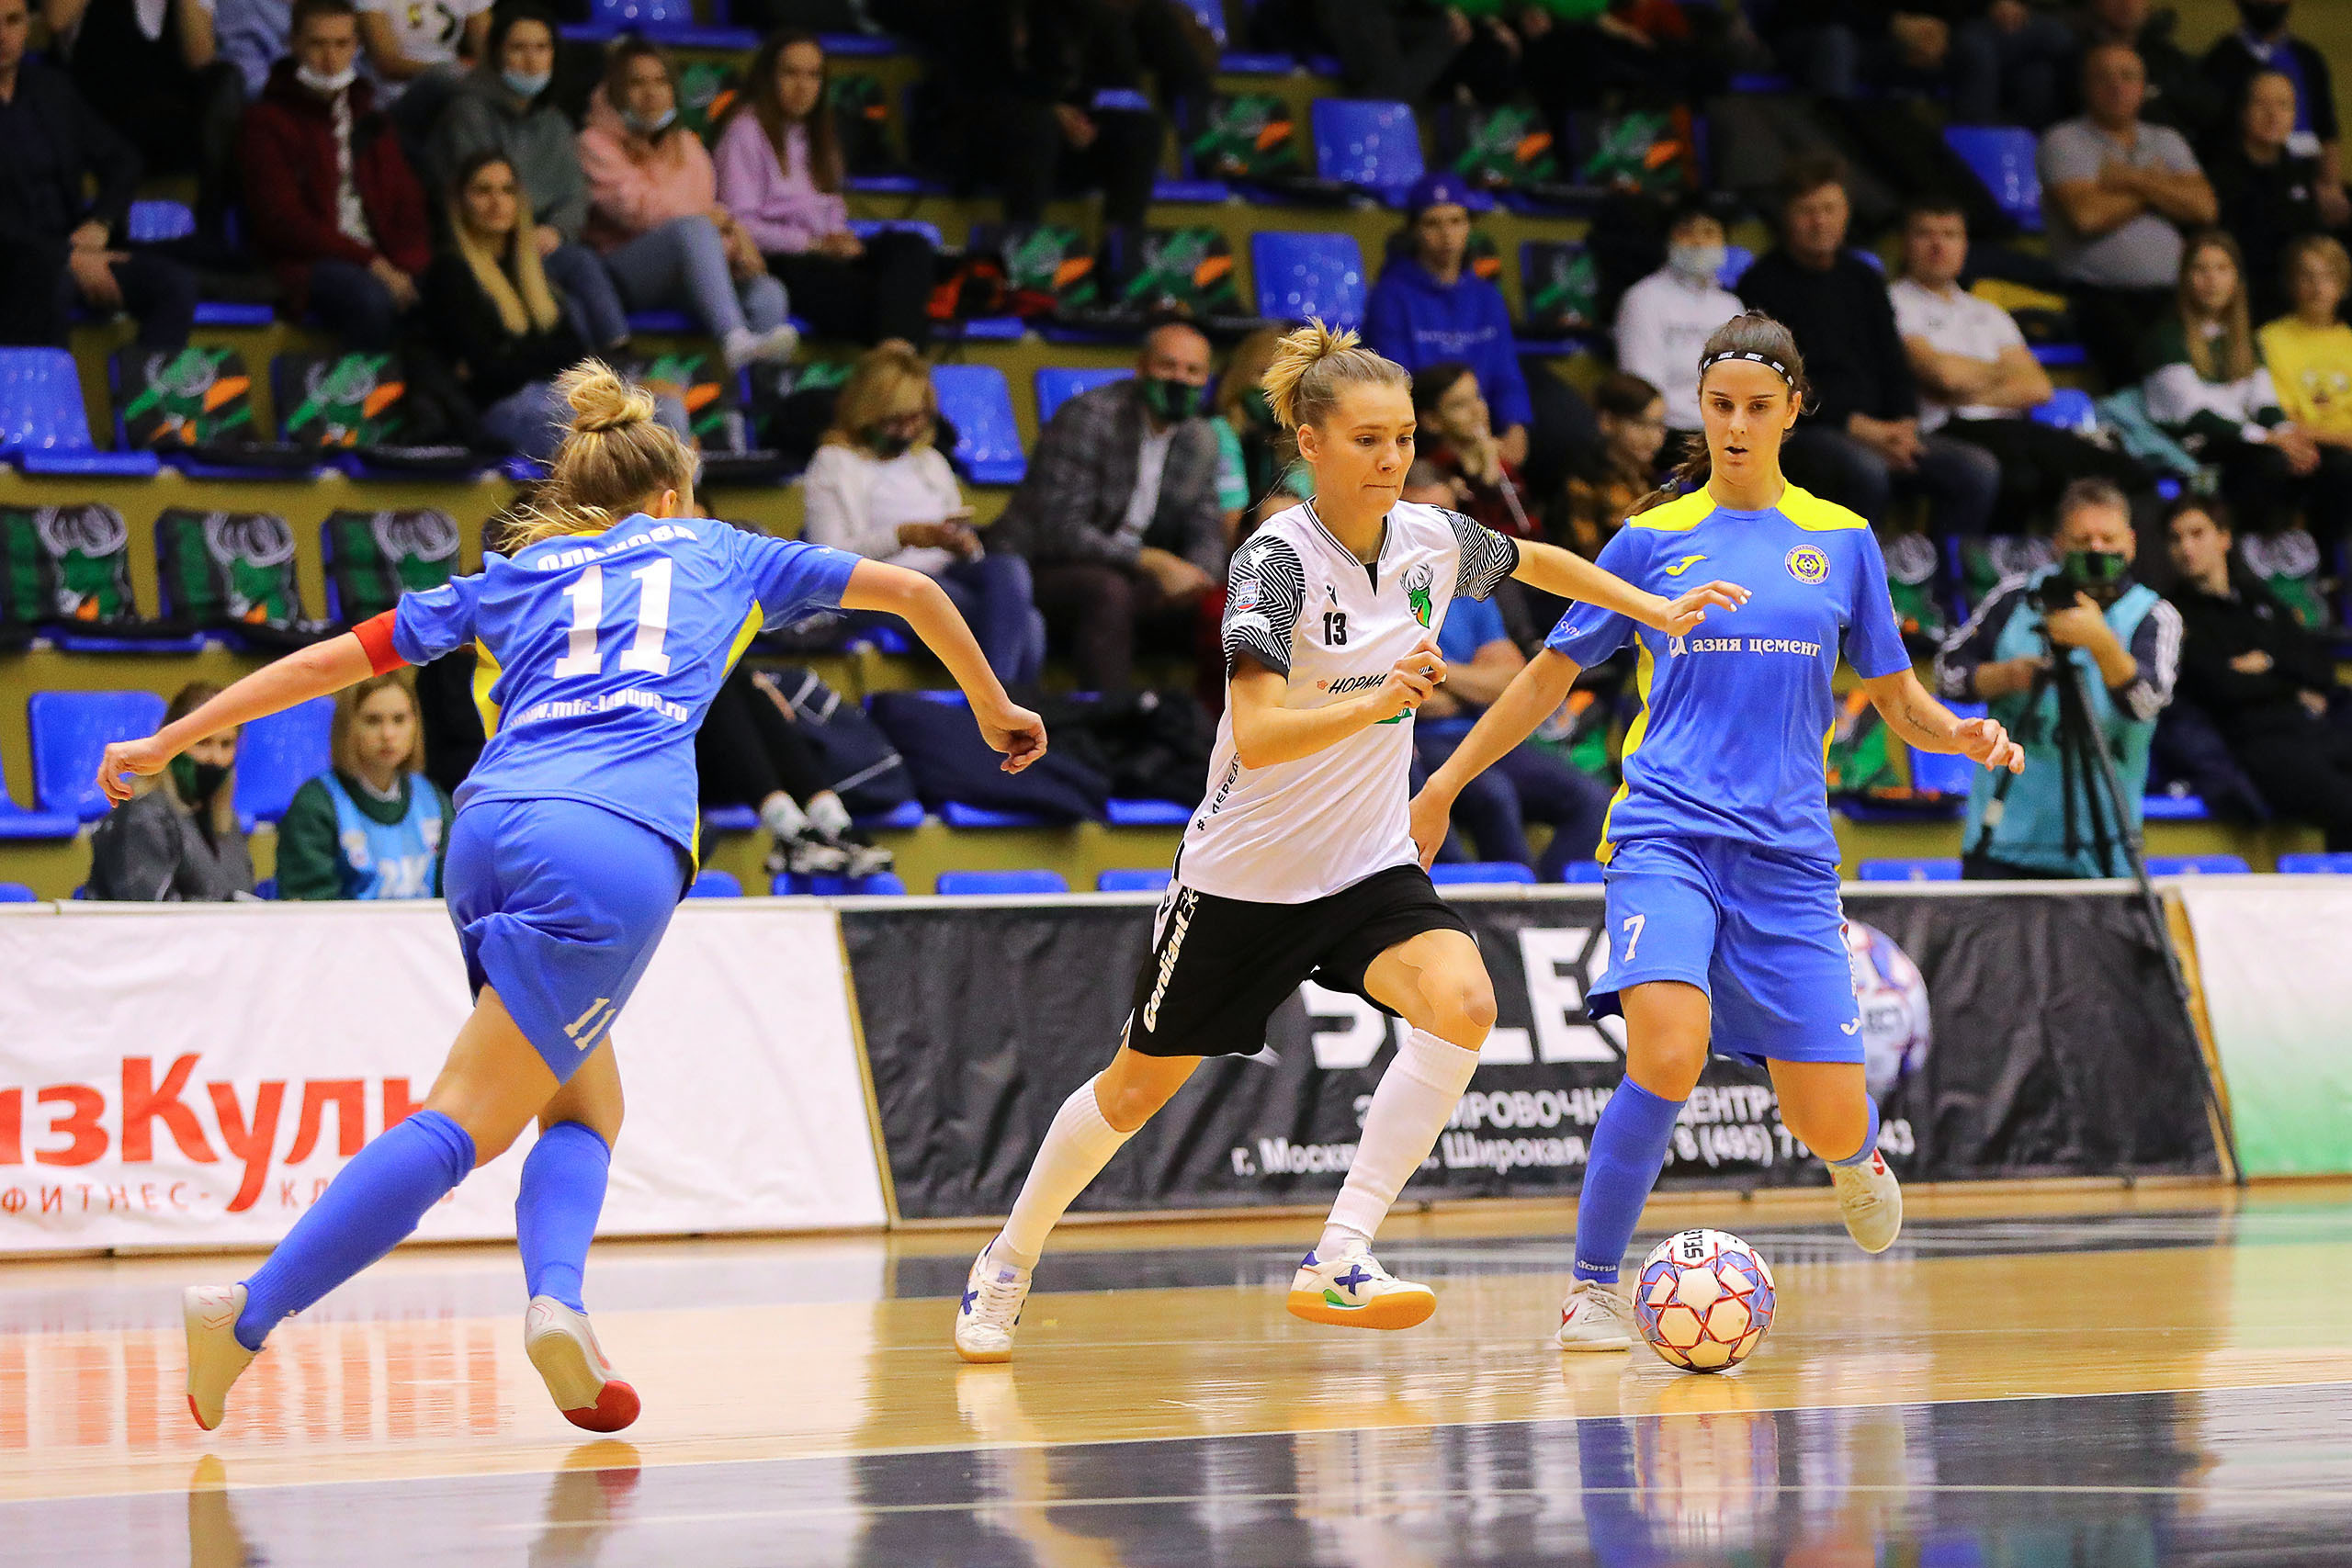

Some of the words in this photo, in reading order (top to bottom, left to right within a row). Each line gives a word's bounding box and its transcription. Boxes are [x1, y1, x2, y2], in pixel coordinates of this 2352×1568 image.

[553, 558, 673, 679] 11
[1323, 612, 1348, 646] 13
[1692, 638, 1741, 653] азия
[1748, 638, 1821, 657] цемент
[1623, 914, 1645, 963] 7
[1143, 910, 1190, 1033] Cordiant
[563, 997, 616, 1052] 11
